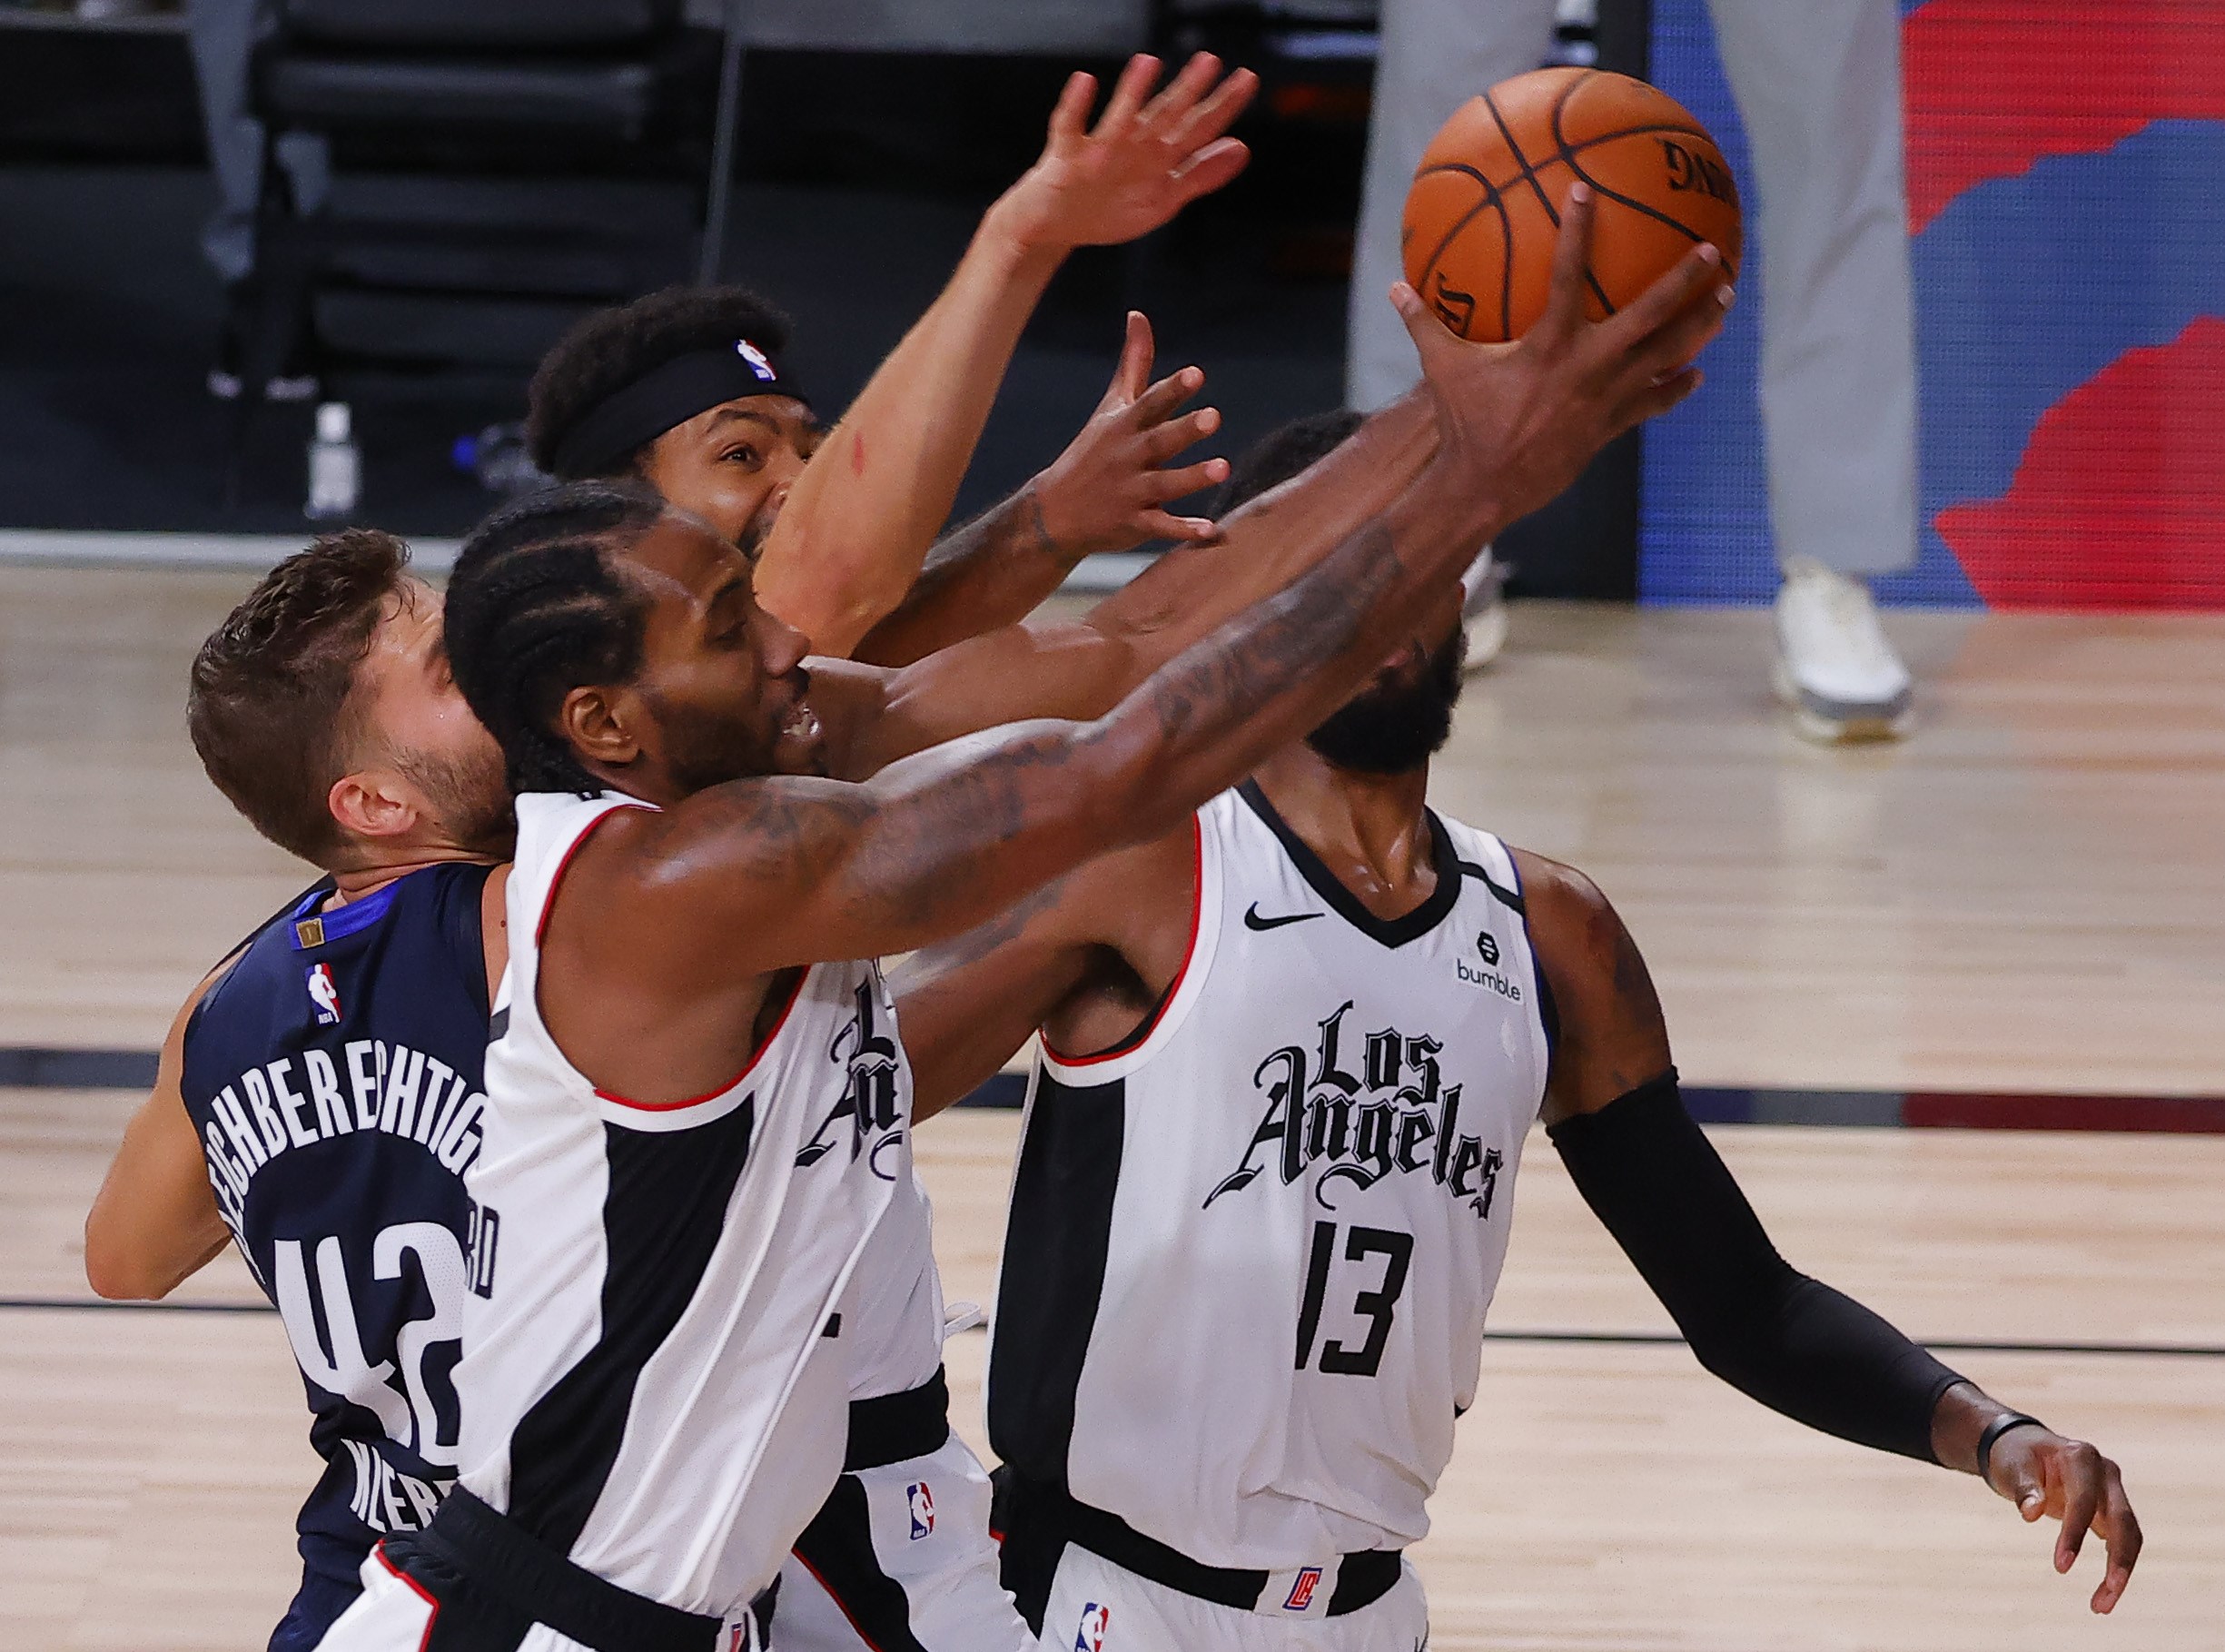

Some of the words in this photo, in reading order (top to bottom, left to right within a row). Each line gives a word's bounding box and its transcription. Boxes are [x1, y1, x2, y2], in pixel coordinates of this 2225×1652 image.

[1309, 999, 1444, 1106] Los
[1456, 957, 1521, 1001] bumble
[1202, 1045, 1504, 1221] Angeles
[274, 1221, 470, 1468] 42
[1294, 1220, 1415, 1378] 13
